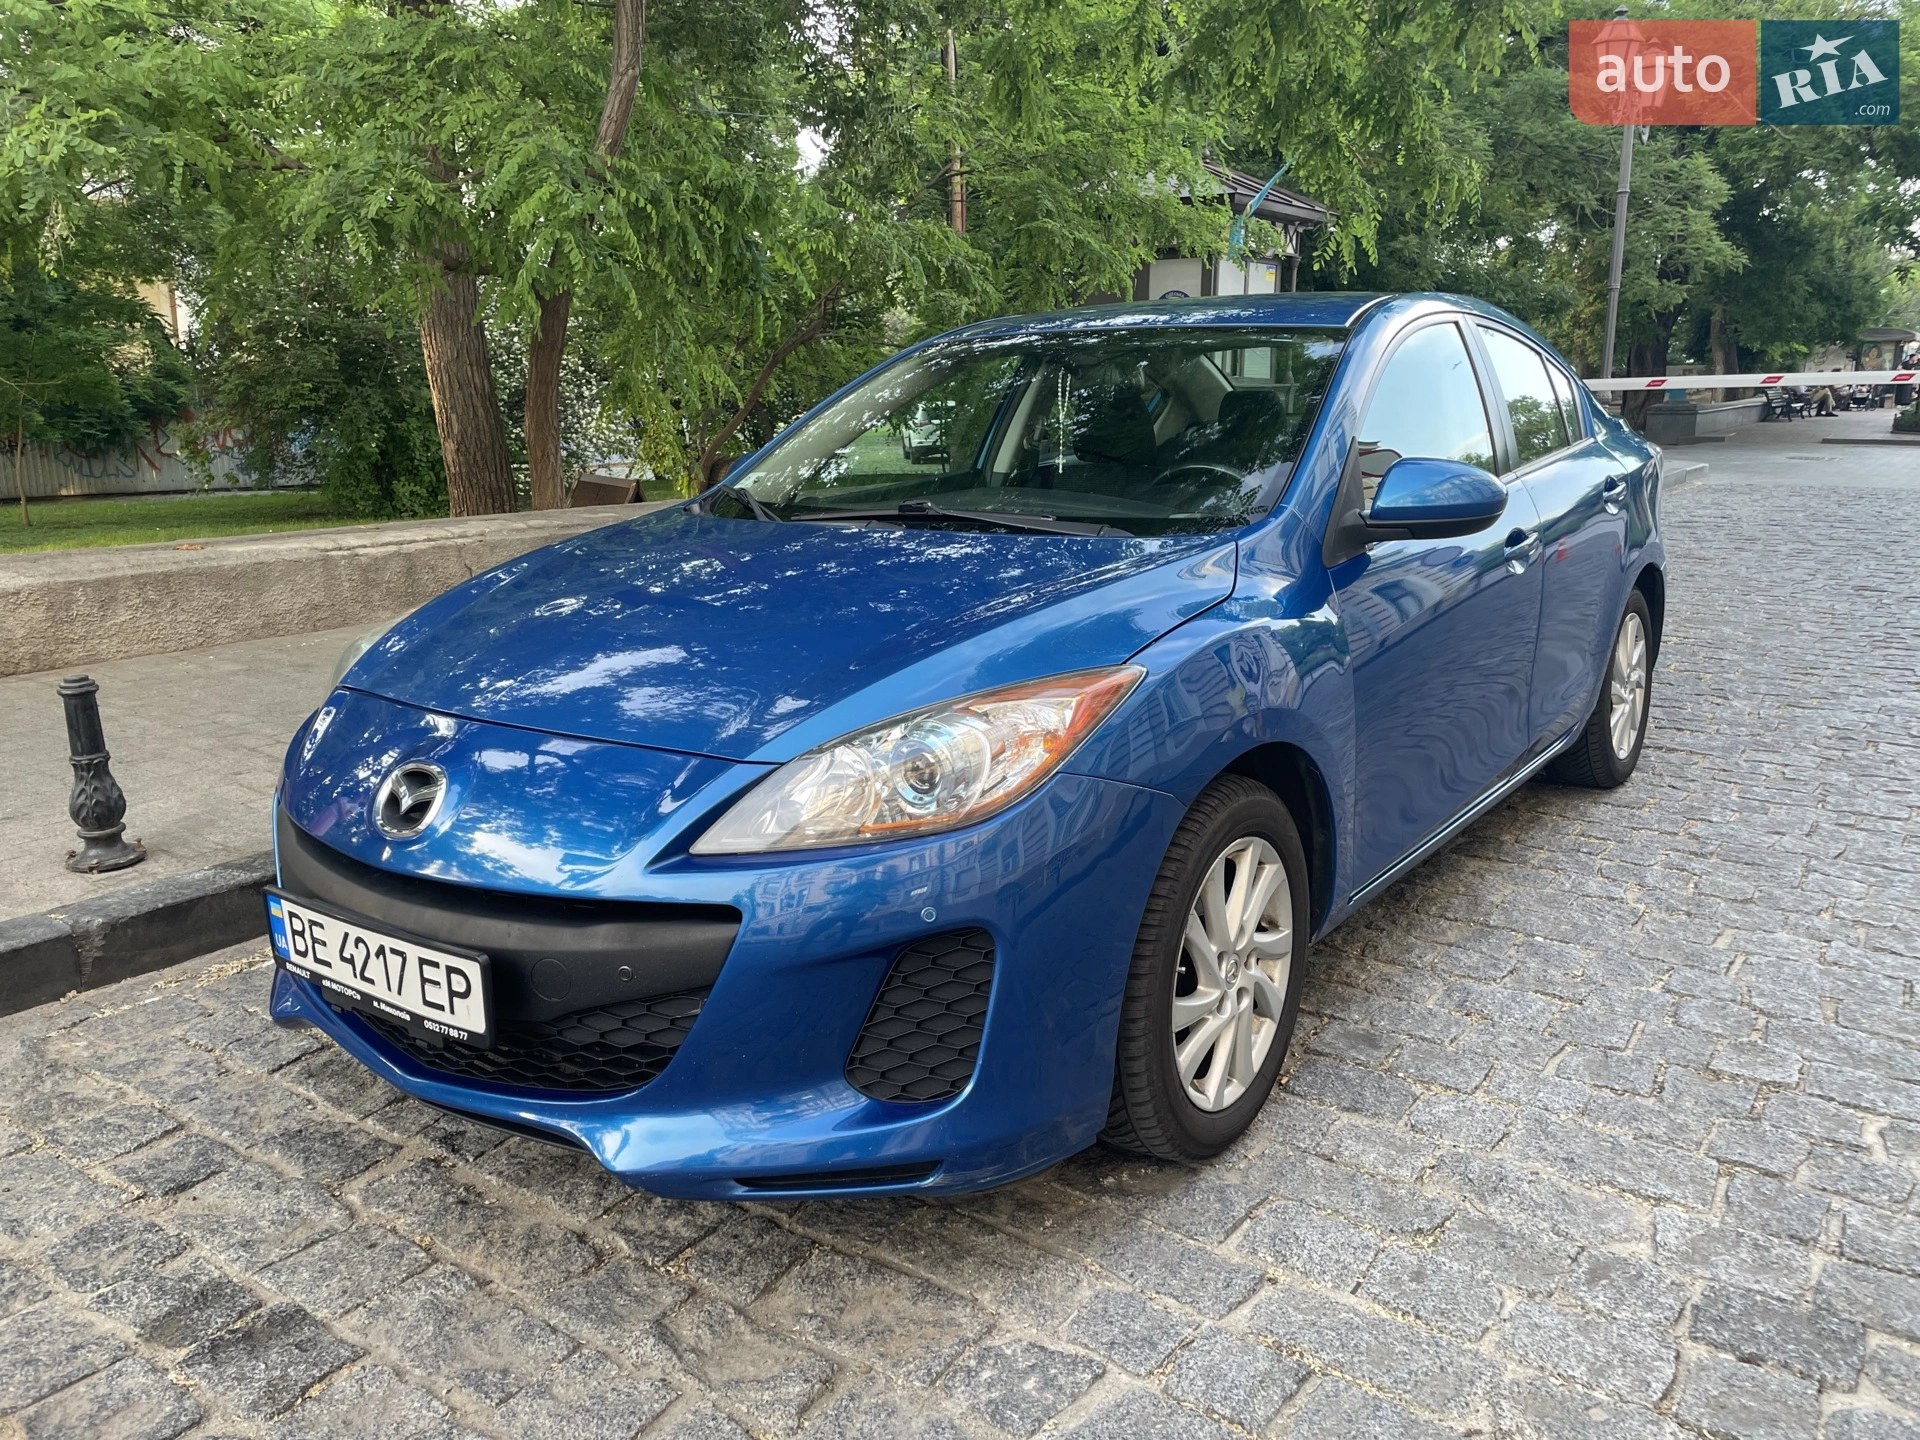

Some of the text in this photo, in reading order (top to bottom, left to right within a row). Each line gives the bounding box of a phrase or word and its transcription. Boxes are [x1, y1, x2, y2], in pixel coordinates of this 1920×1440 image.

[274, 933, 288, 951] UA
[285, 962, 311, 979] RENAULT
[288, 909, 472, 1015] BE 4217 EP
